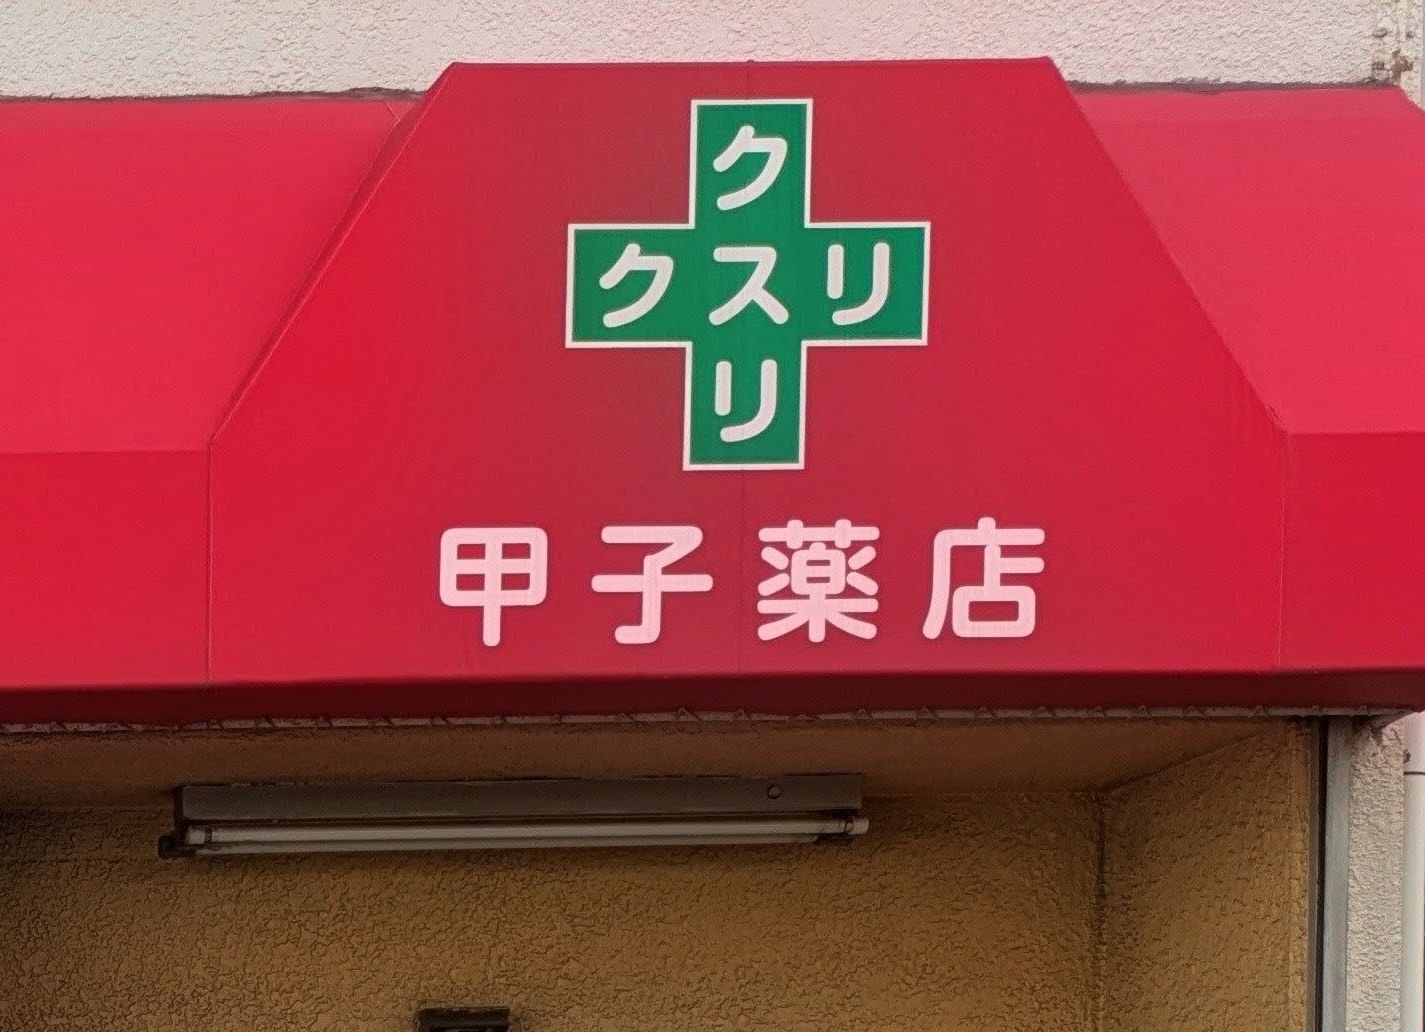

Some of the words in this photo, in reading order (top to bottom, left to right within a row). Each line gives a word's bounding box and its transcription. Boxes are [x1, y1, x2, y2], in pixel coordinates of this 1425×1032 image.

[598, 242, 891, 328] クスリ
[440, 516, 1046, 648] 甲子薬店
